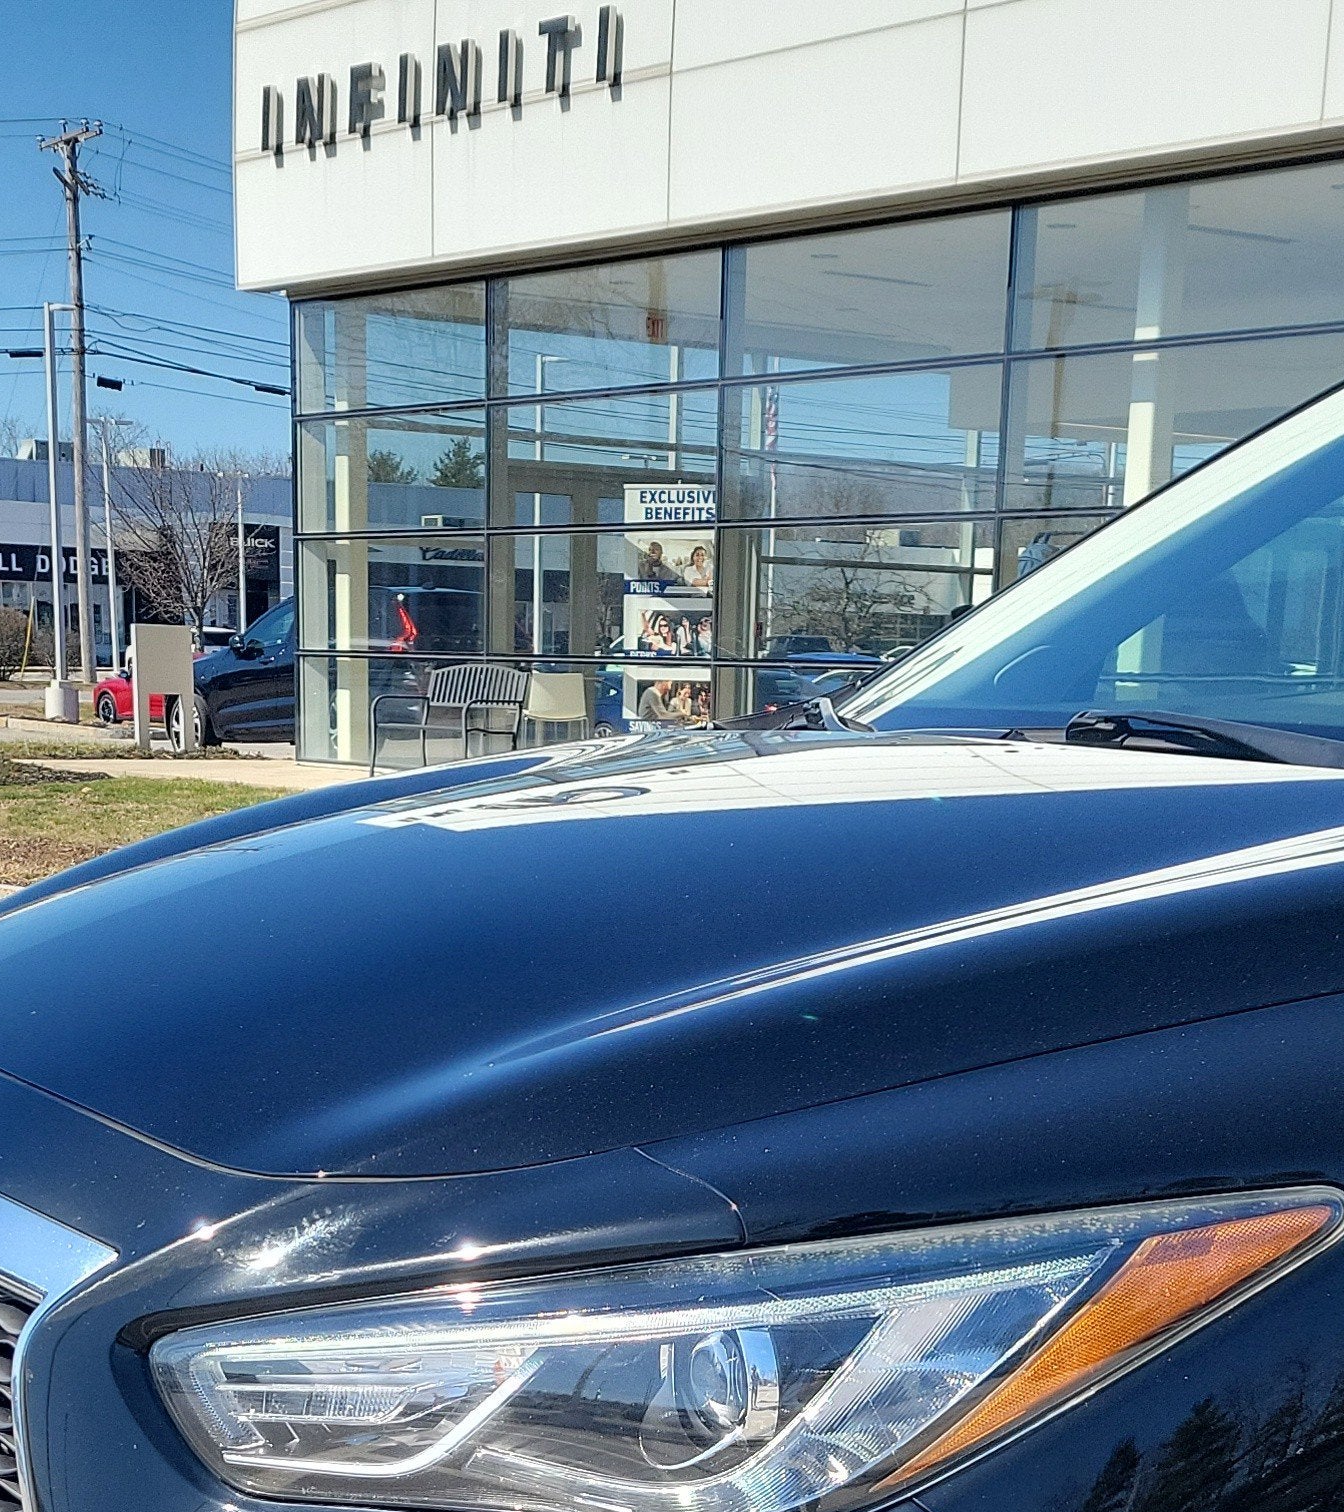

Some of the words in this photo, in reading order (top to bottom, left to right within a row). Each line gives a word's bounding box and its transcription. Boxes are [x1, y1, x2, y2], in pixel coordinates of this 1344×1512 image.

[260, 4, 620, 155] INFINITI
[644, 506, 716, 520] BENEFITS
[35, 554, 111, 576] DDGE
